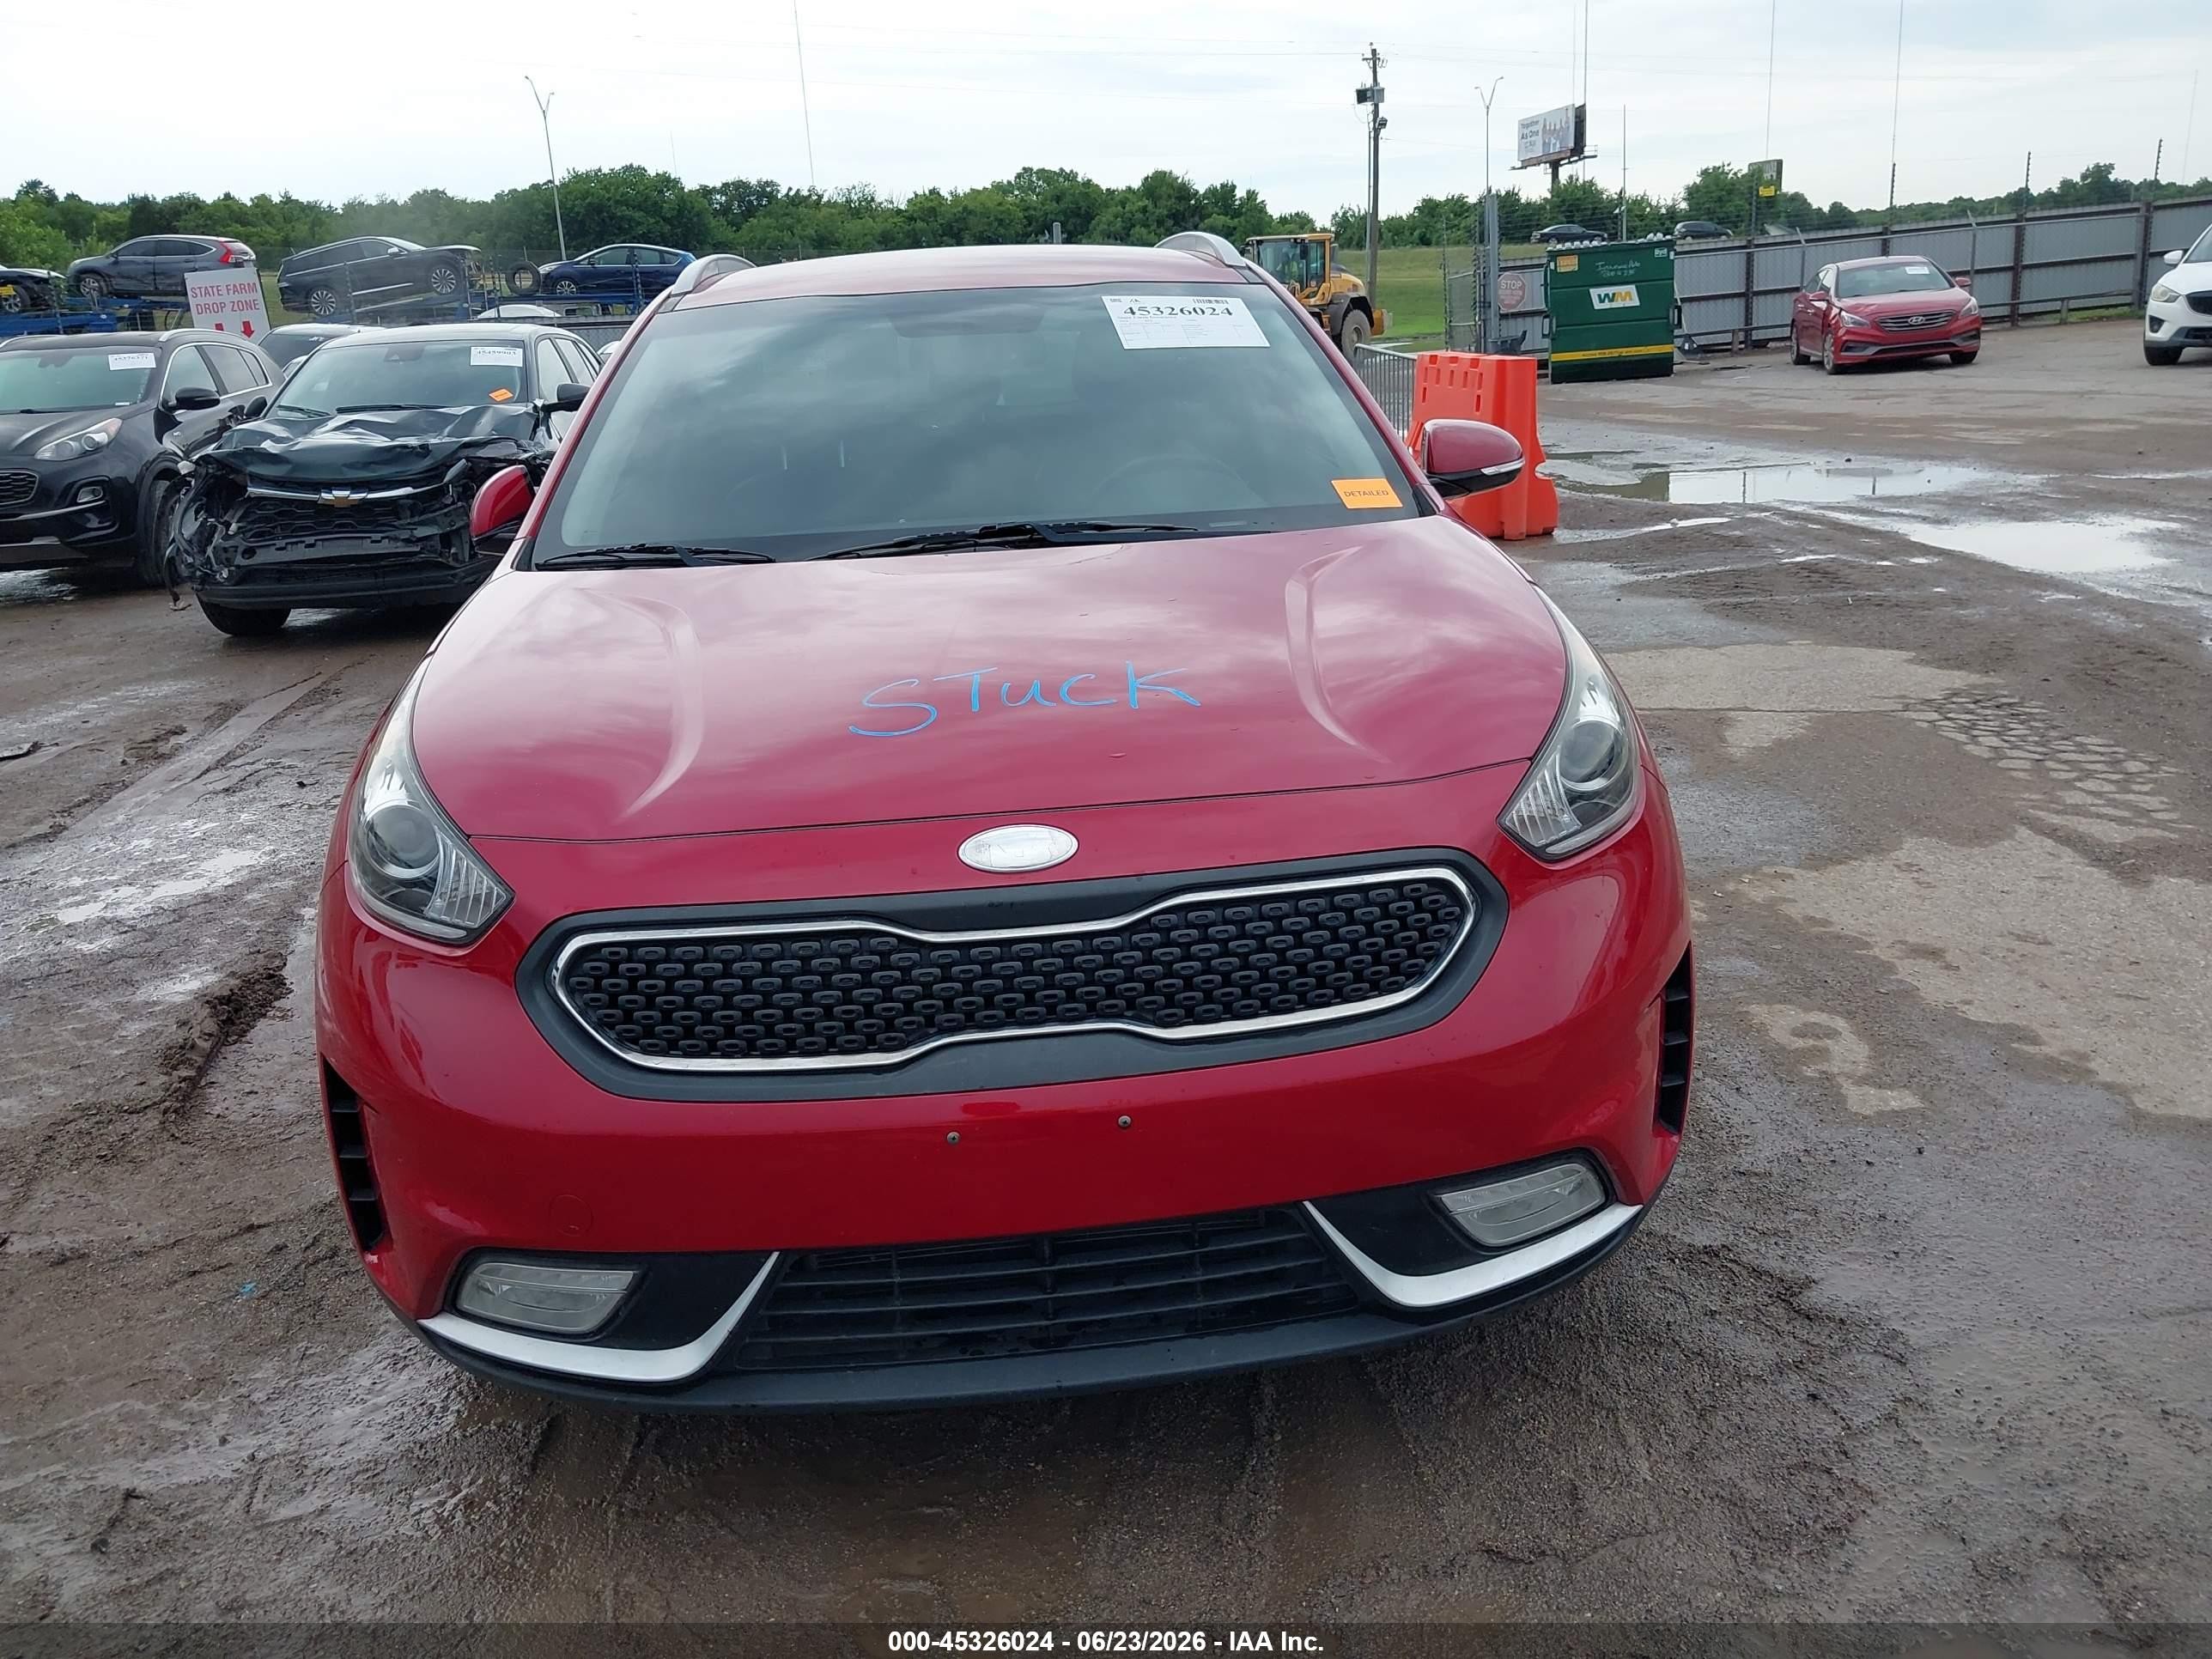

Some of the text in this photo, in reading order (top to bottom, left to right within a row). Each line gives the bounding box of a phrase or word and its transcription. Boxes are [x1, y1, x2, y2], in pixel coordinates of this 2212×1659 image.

[191, 283, 258, 299] STATE FARM
[1500, 280, 1522, 289] STOP
[1597, 290, 1632, 304] WM
[195, 299, 260, 315] DROP ZONE
[1123, 306, 1233, 317] 45326024
